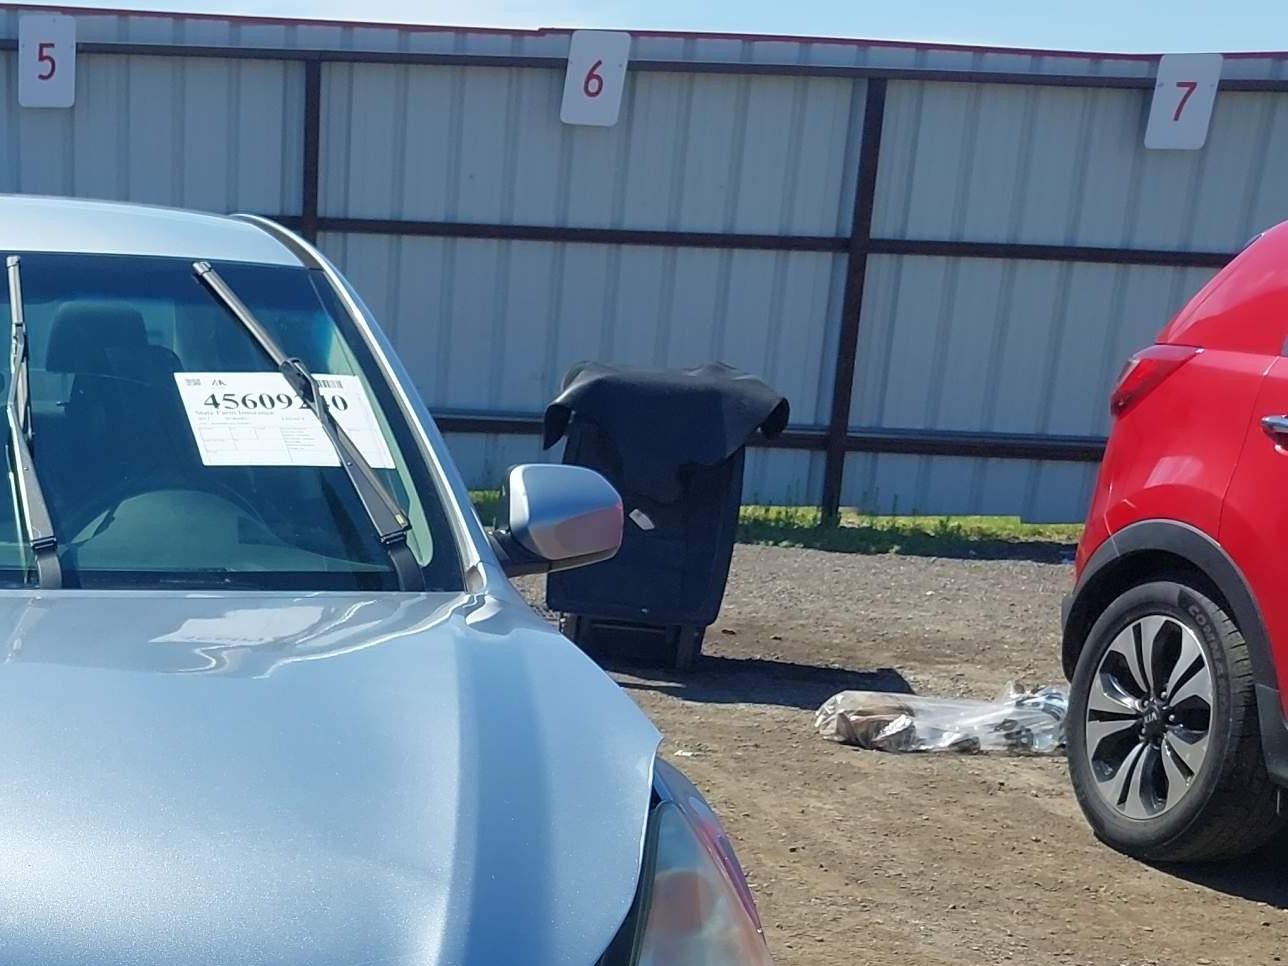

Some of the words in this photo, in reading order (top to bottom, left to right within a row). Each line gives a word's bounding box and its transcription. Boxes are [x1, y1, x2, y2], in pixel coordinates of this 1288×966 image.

[37, 42, 57, 81] 5
[583, 59, 604, 98] 6
[1173, 81, 1198, 122] 7
